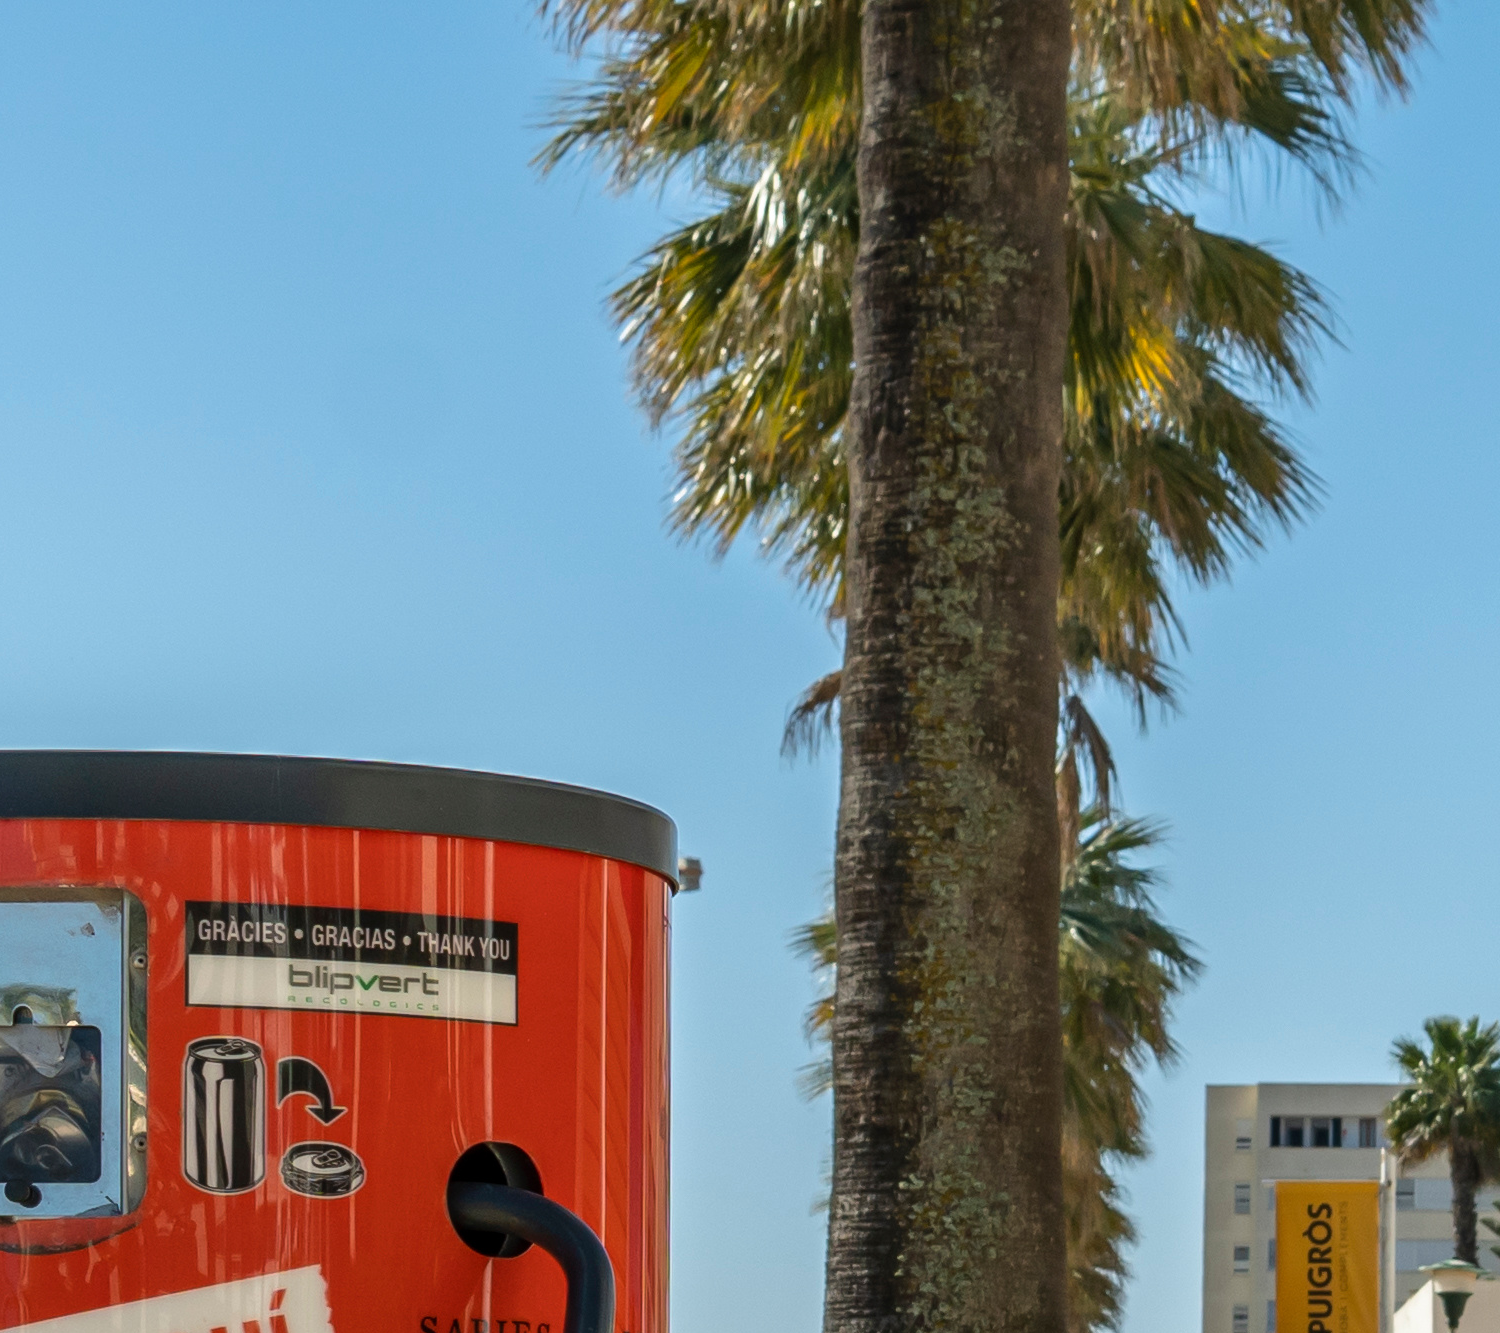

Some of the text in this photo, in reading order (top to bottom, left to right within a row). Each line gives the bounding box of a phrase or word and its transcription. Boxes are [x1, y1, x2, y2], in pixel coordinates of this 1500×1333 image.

[198, 915, 511, 961] GRÀCIES GRACIAS THANK YOU
[288, 963, 440, 996] blipvert
